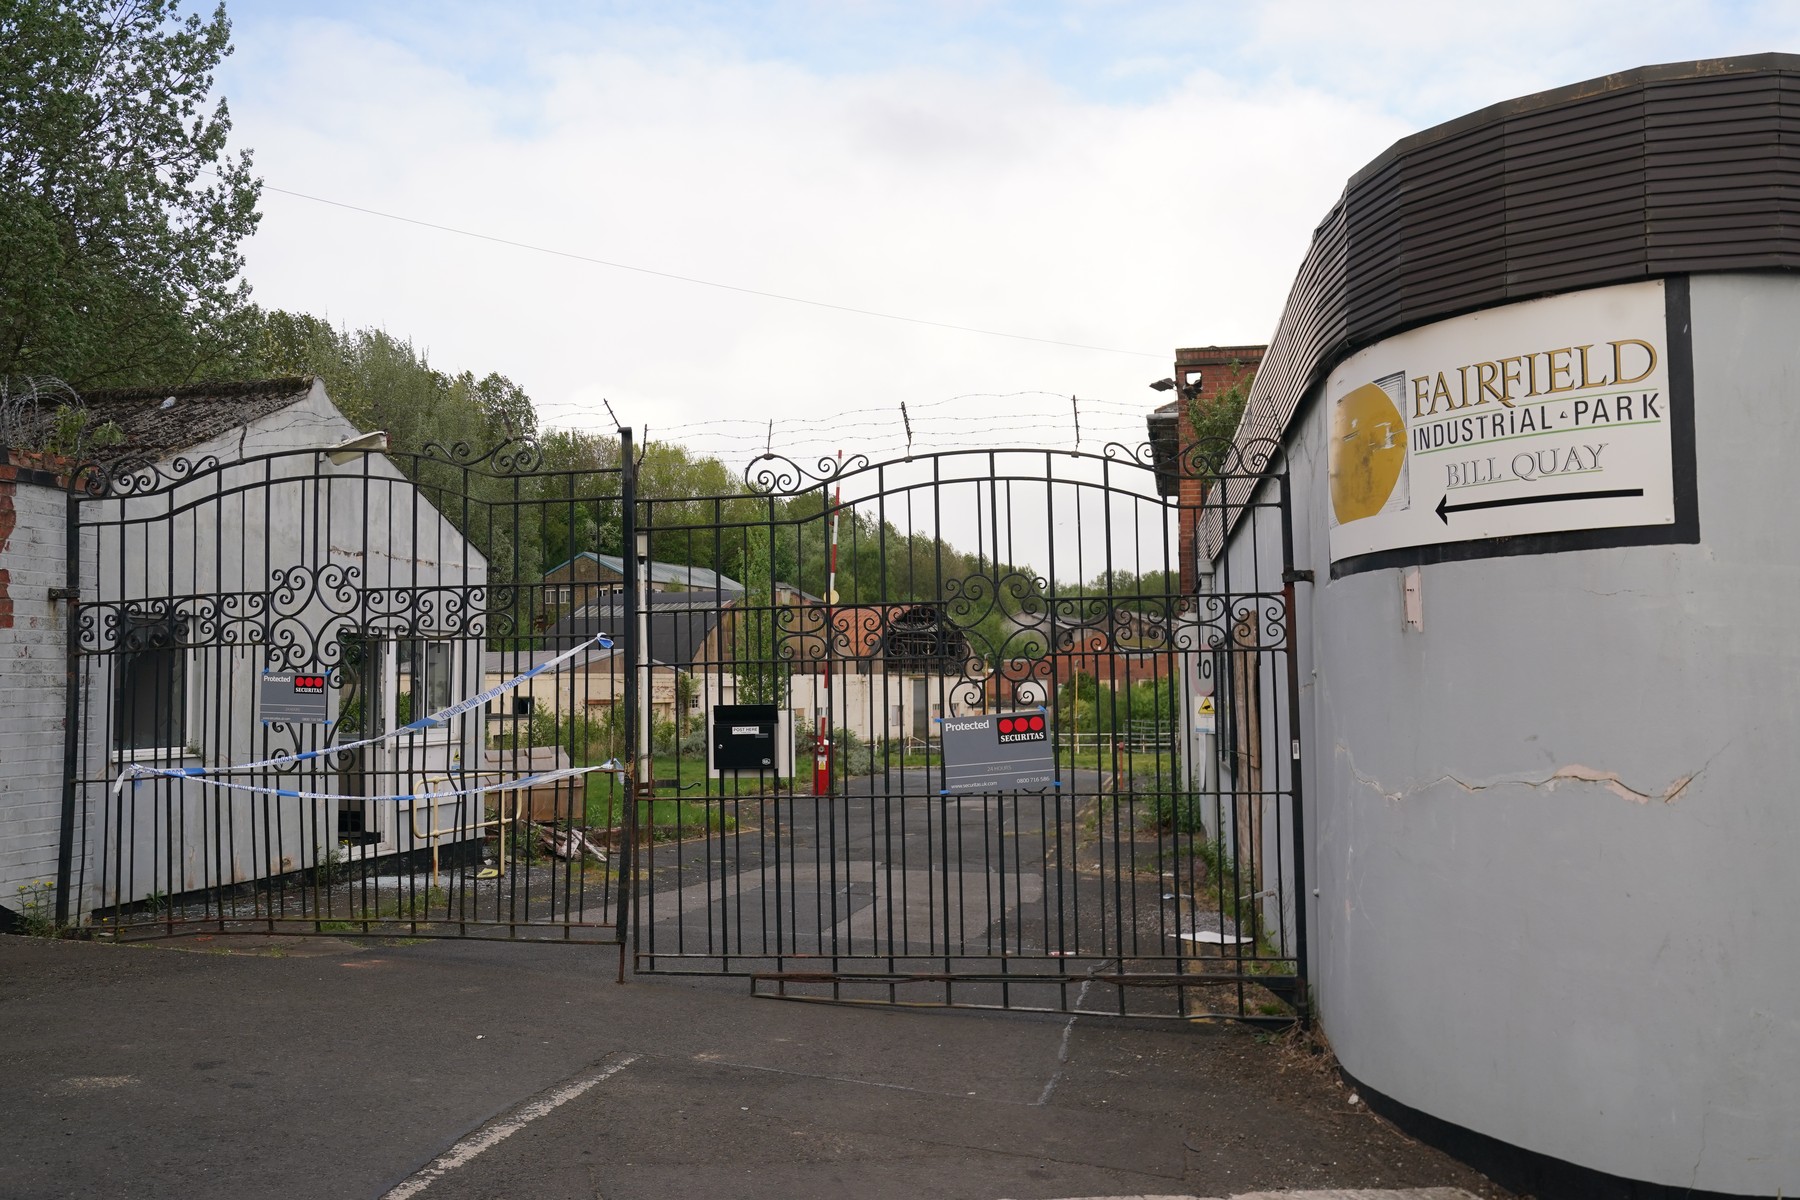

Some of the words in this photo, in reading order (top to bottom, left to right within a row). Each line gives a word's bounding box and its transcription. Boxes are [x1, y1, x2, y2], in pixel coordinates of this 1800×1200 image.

[1412, 338, 1658, 419] FAIRFIELD
[1574, 392, 1661, 426] PARK
[1446, 456, 1502, 488] BILL
[1511, 442, 1609, 482] QUAY
[263, 675, 291, 683] Protected
[439, 704, 464, 720] POLICE
[463, 697, 480, 709] LINE
[478, 692, 489, 702] DO
[489, 687, 503, 698] NOT
[503, 675, 524, 691] CROSS
[945, 720, 990, 732] Protected
[1000, 731, 1045, 743] SECURITAS
